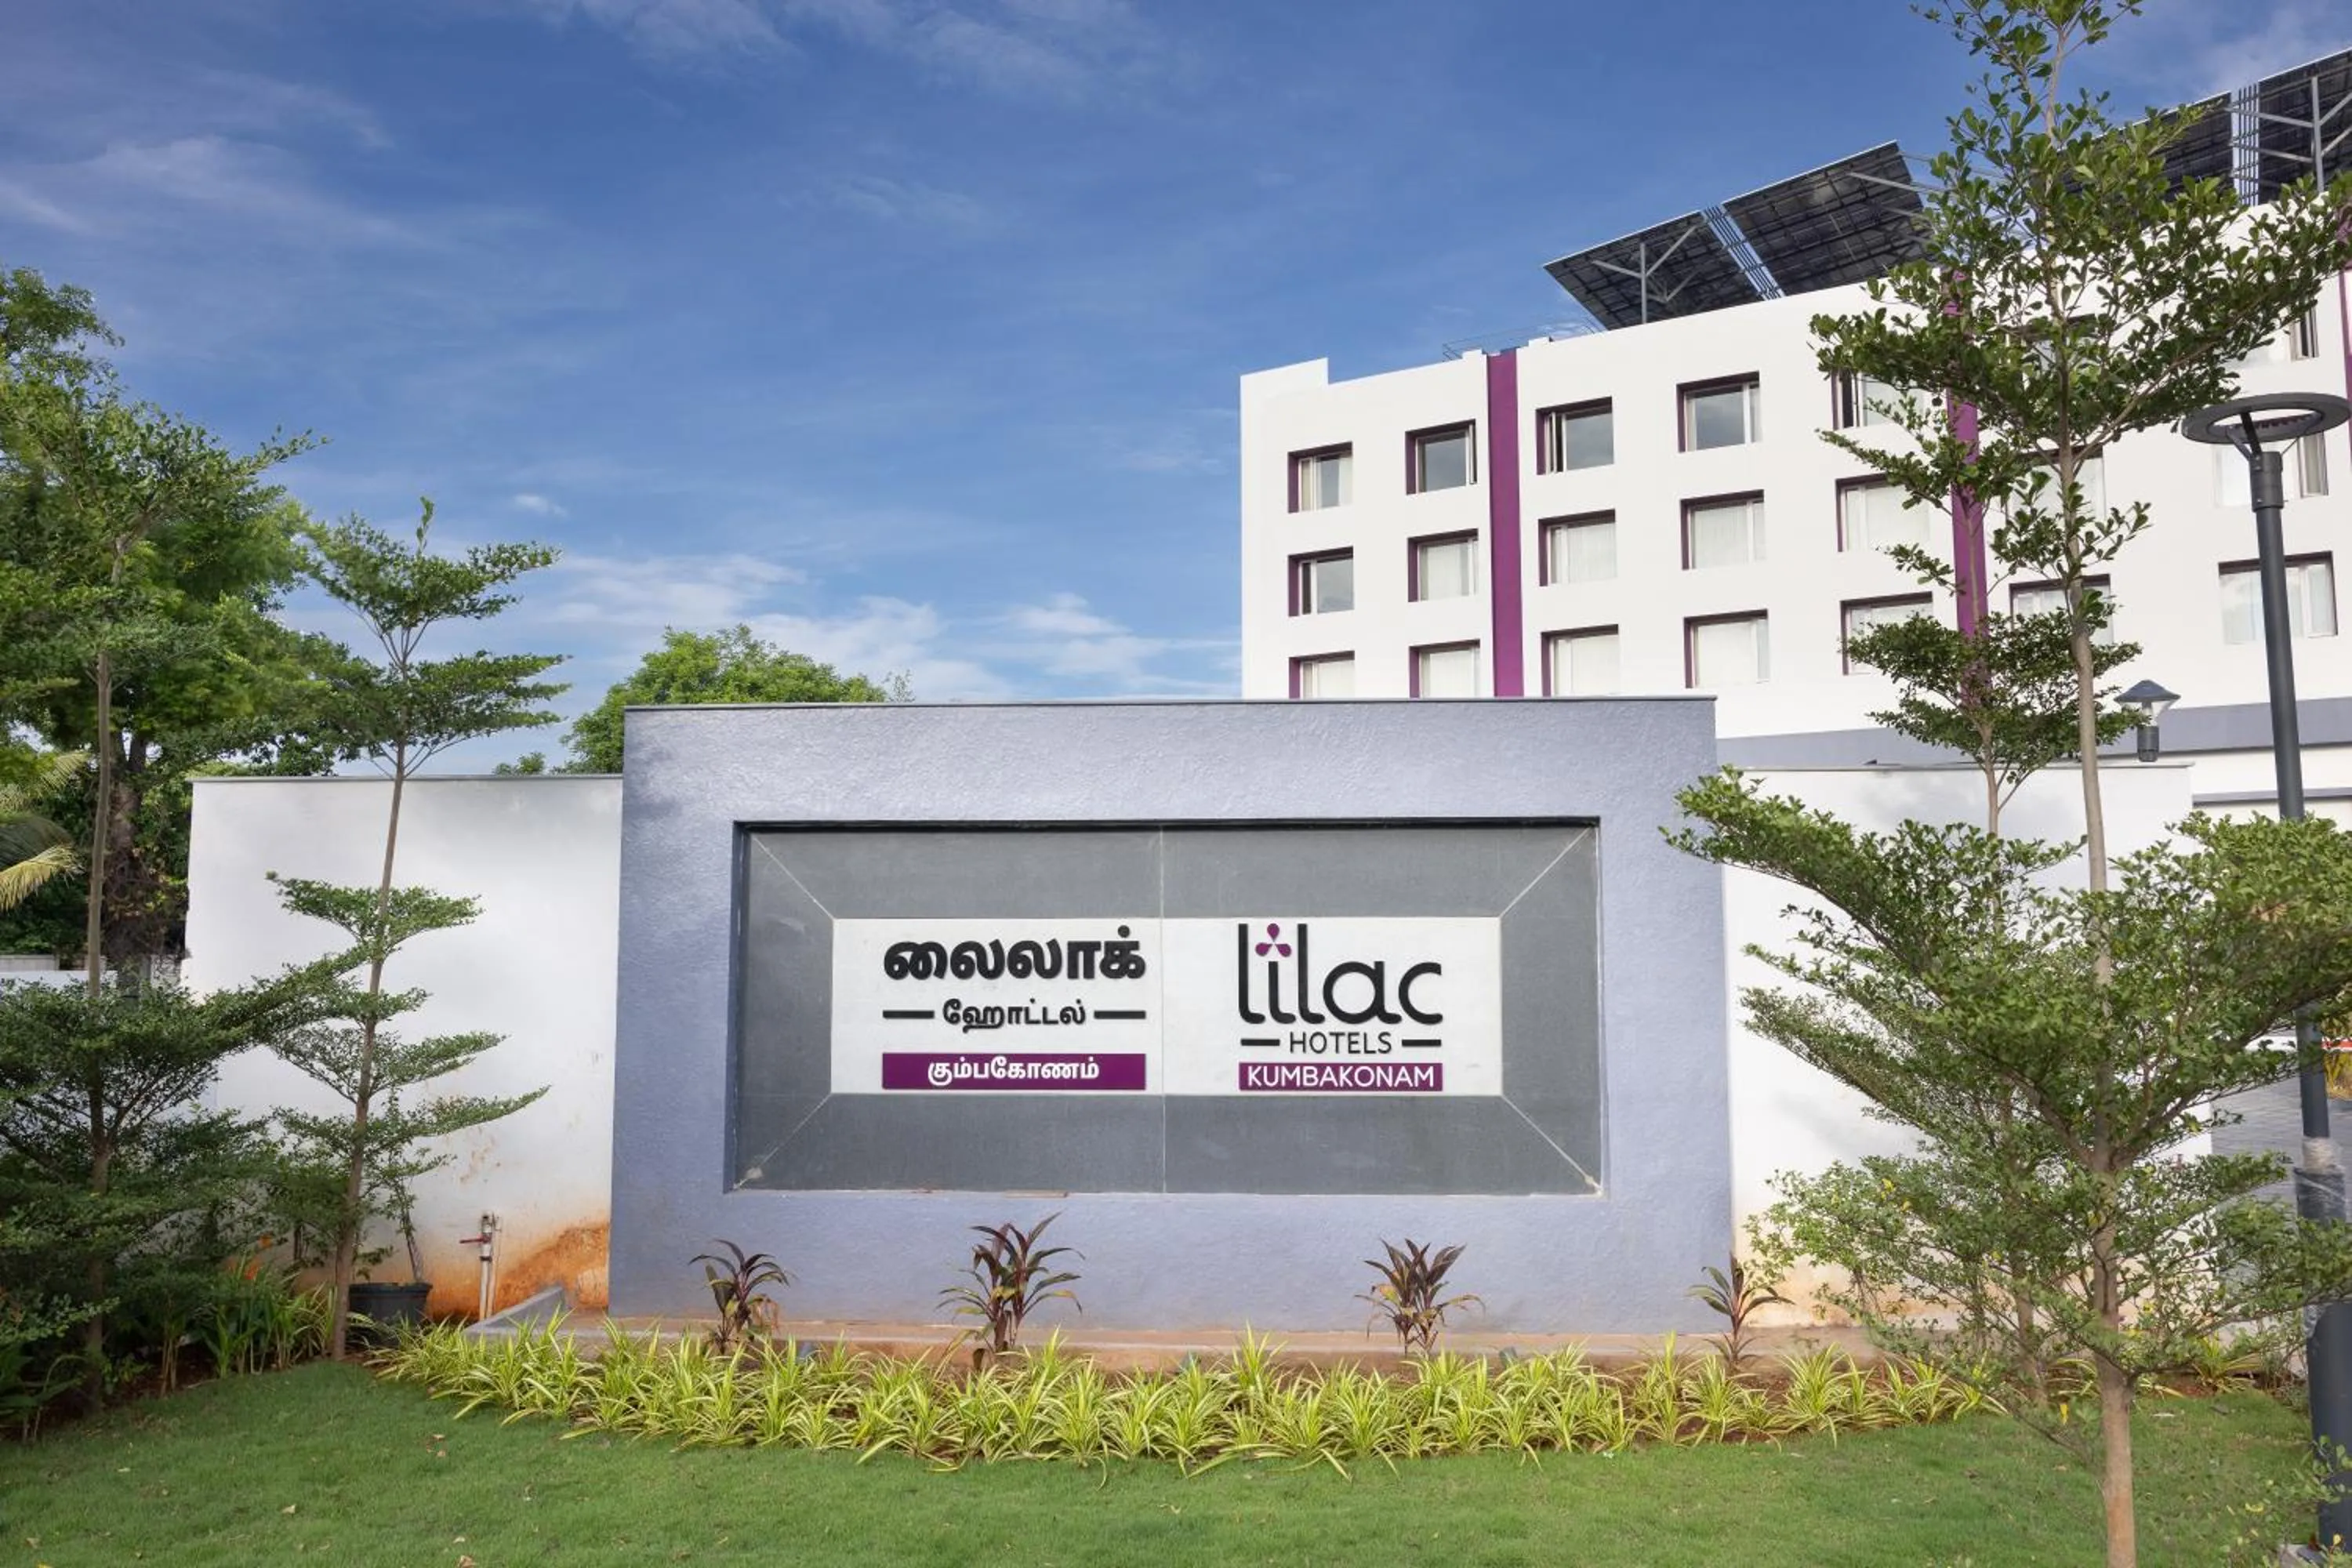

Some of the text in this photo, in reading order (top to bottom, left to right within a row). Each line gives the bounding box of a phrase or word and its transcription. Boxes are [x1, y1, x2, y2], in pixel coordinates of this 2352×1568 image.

[884, 925, 1146, 980] லைலாக்
[1238, 923, 1443, 1025] lilac
[942, 998, 1086, 1033] ஹோட்டல்
[1290, 1031, 1392, 1054] HOTELS
[927, 1056, 1100, 1086] கும்பகோணம்
[1247, 1065, 1435, 1087] KUMBAKONAM
